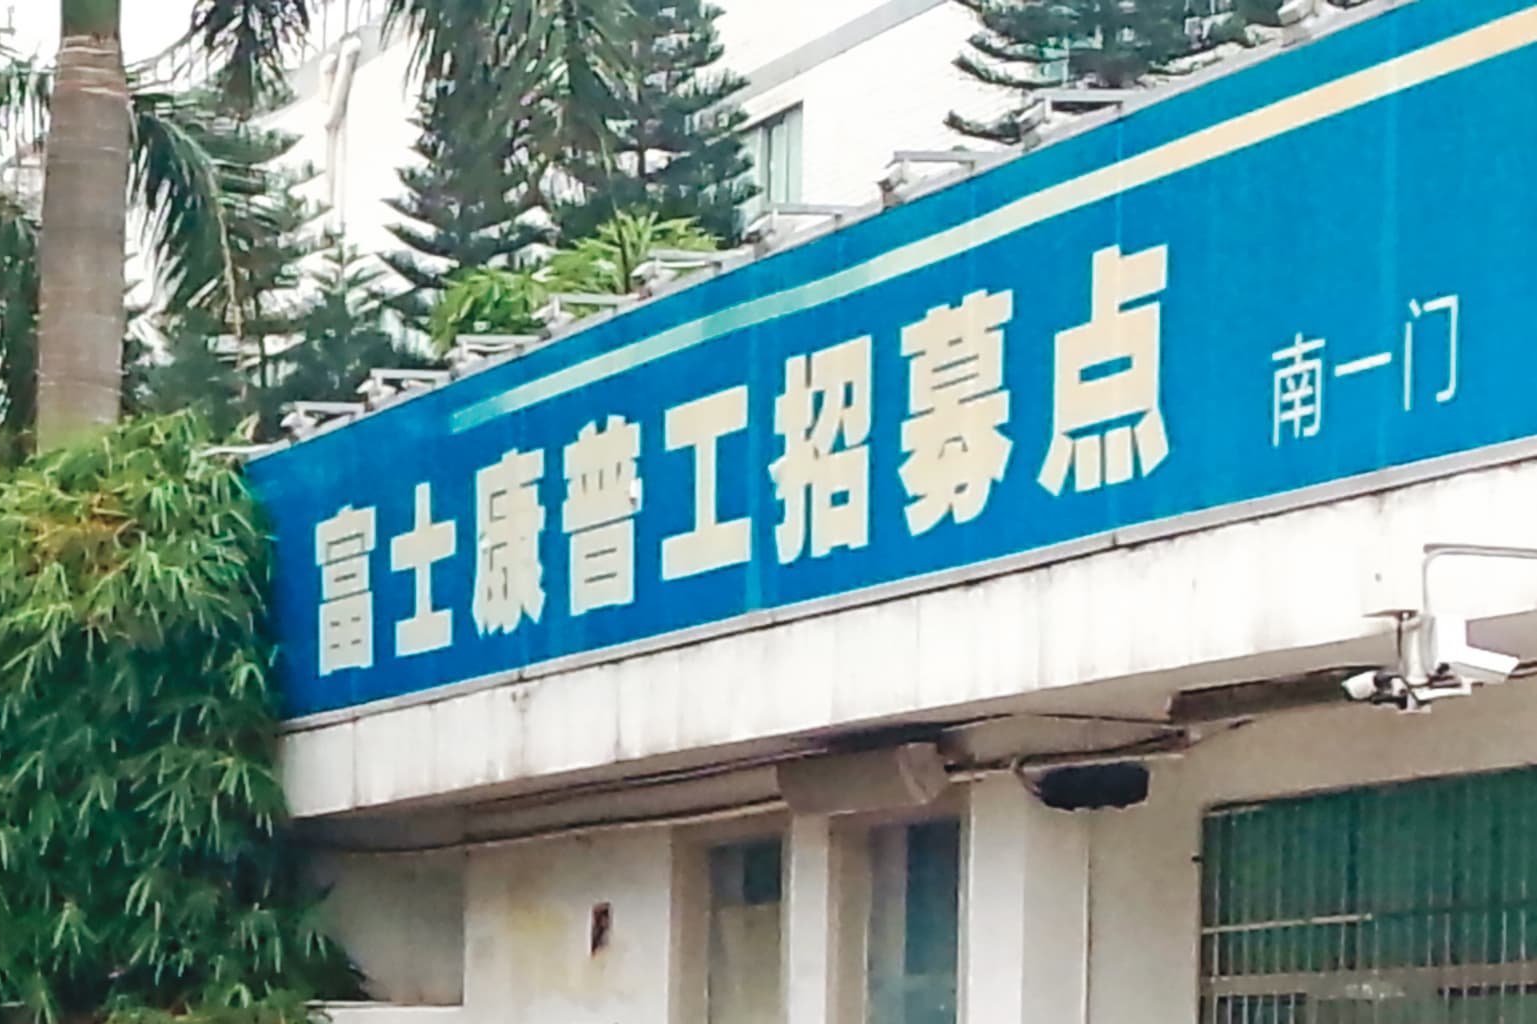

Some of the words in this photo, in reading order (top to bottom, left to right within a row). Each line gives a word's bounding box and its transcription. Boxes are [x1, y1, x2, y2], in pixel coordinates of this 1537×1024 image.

[315, 243, 1170, 678] 富士康普工招募点
[1271, 294, 1459, 447] 南一门
